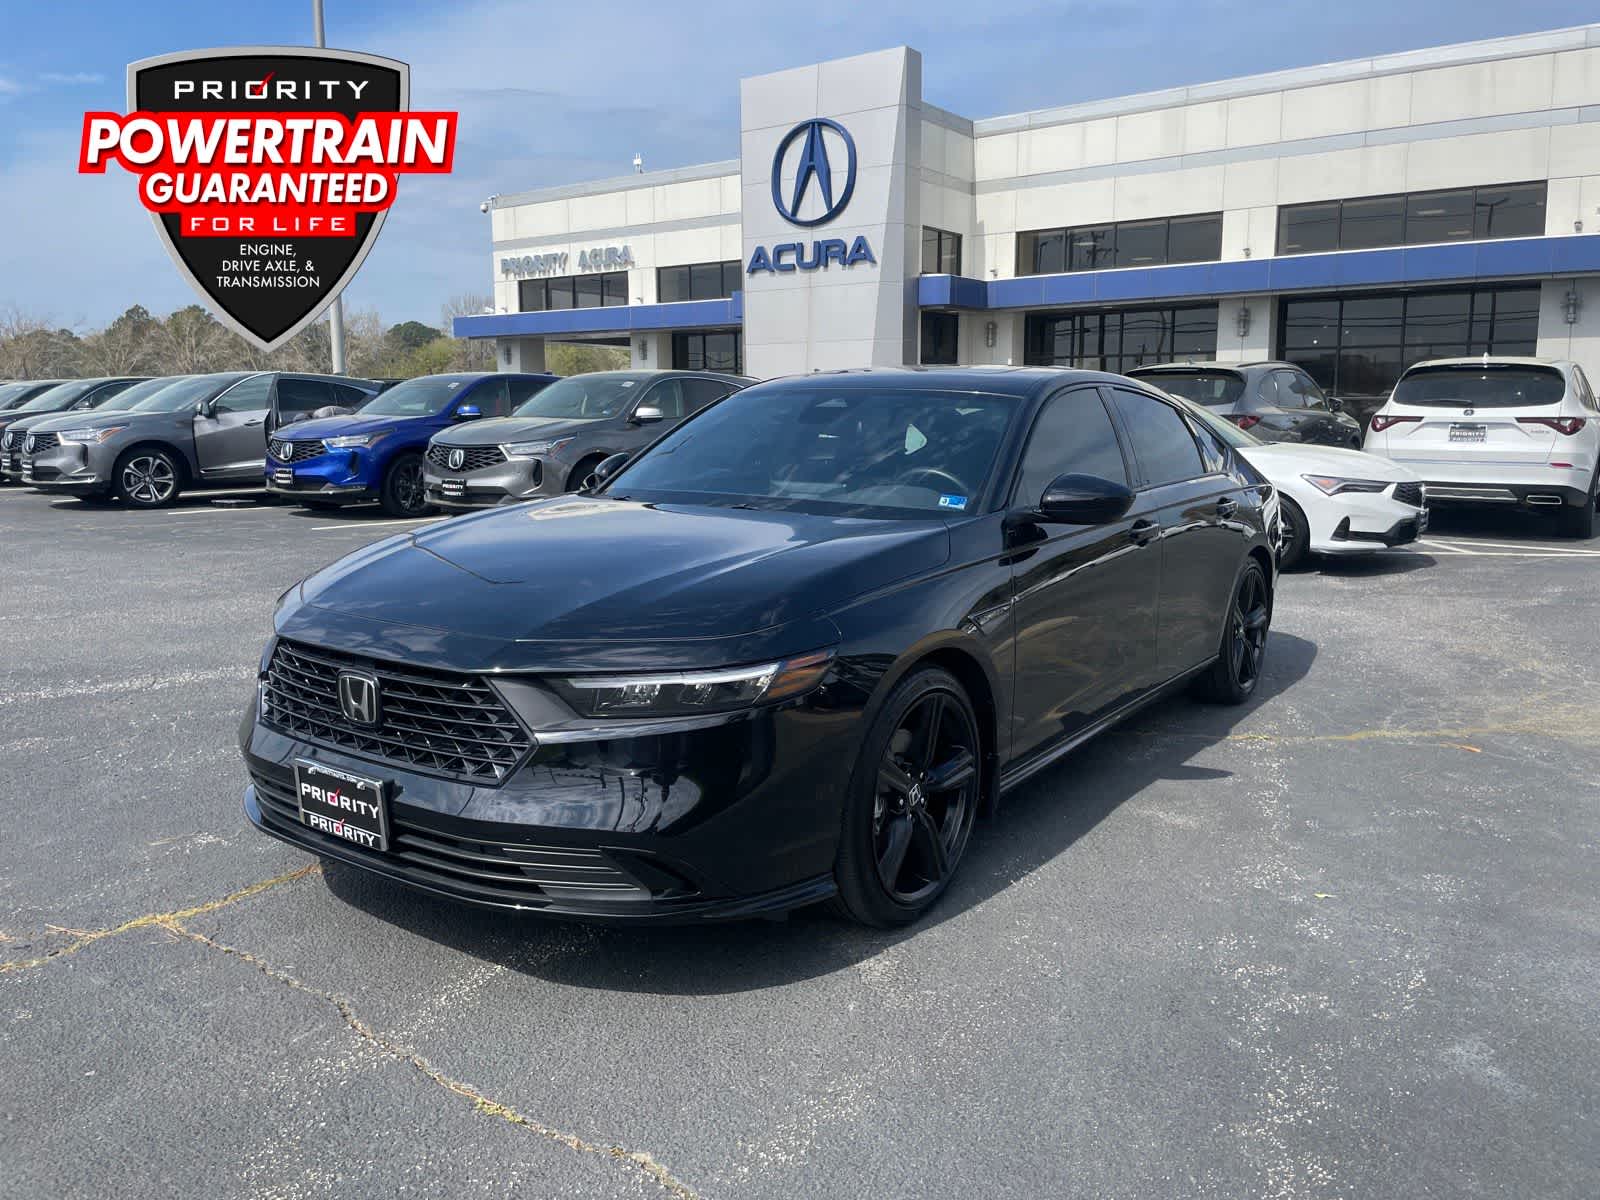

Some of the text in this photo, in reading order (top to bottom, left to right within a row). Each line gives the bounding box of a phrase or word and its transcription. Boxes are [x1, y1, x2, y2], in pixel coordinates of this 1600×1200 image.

[500, 245, 635, 279] PRIORITY ACURA
[746, 235, 878, 274] ACURA
[301, 782, 379, 819] PRIORITY
[310, 814, 375, 847] PRIORITY
